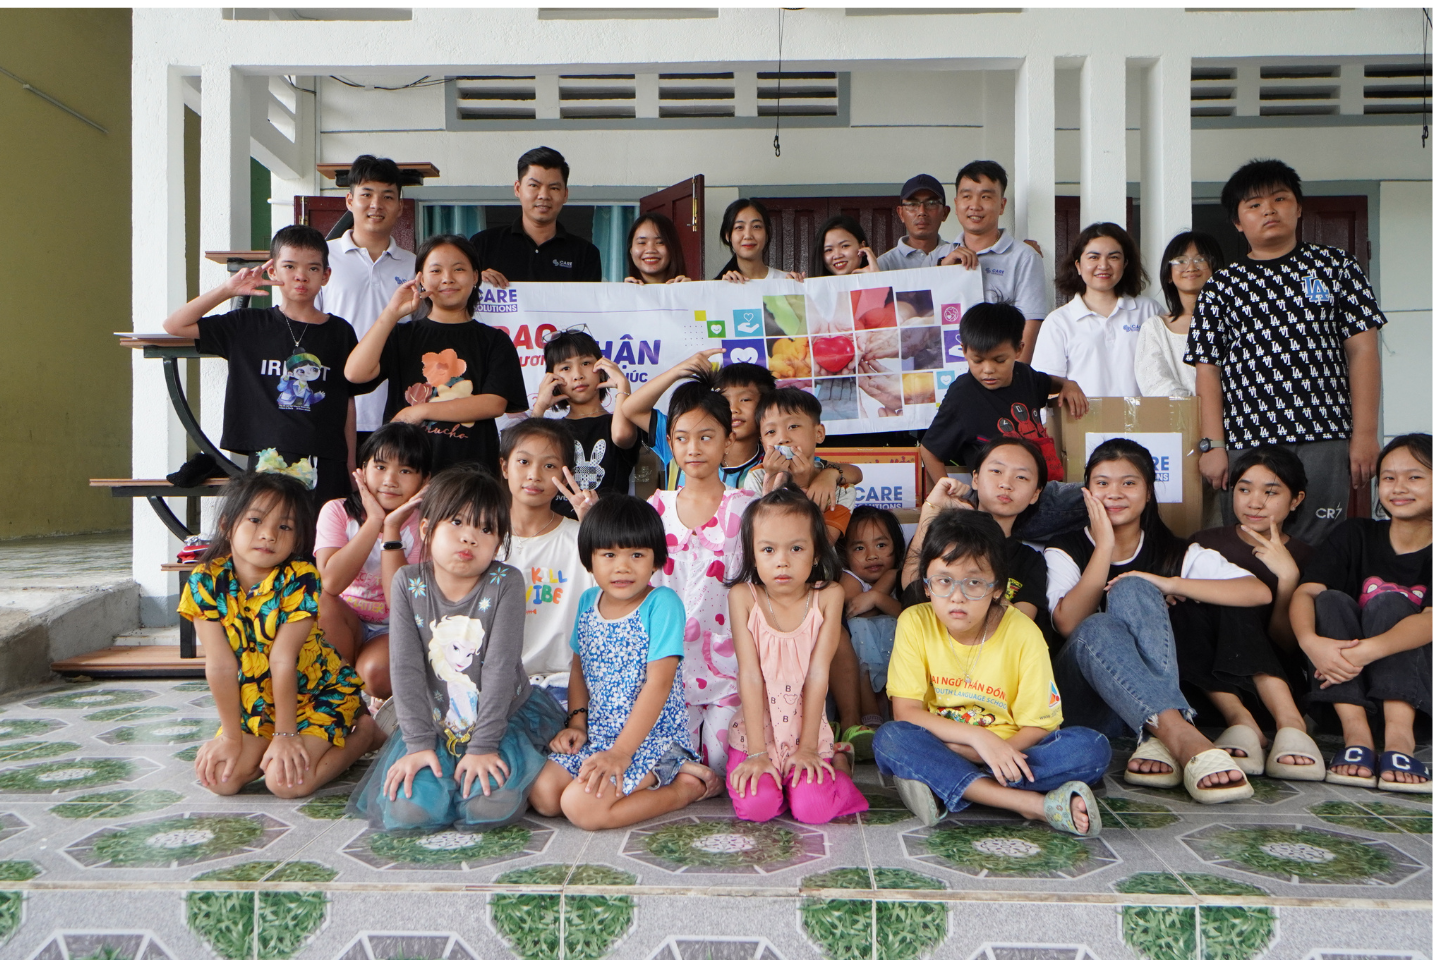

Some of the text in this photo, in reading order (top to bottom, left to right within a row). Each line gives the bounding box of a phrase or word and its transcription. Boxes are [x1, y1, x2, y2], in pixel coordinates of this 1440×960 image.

[1303, 275, 1329, 302] LA
[474, 305, 517, 313] OLUTIONS
[601, 334, 661, 369] HẬN
[855, 486, 903, 502] CARE
[954, 691, 985, 702] LANGUAGE
[986, 698, 1008, 710] SCHOO
